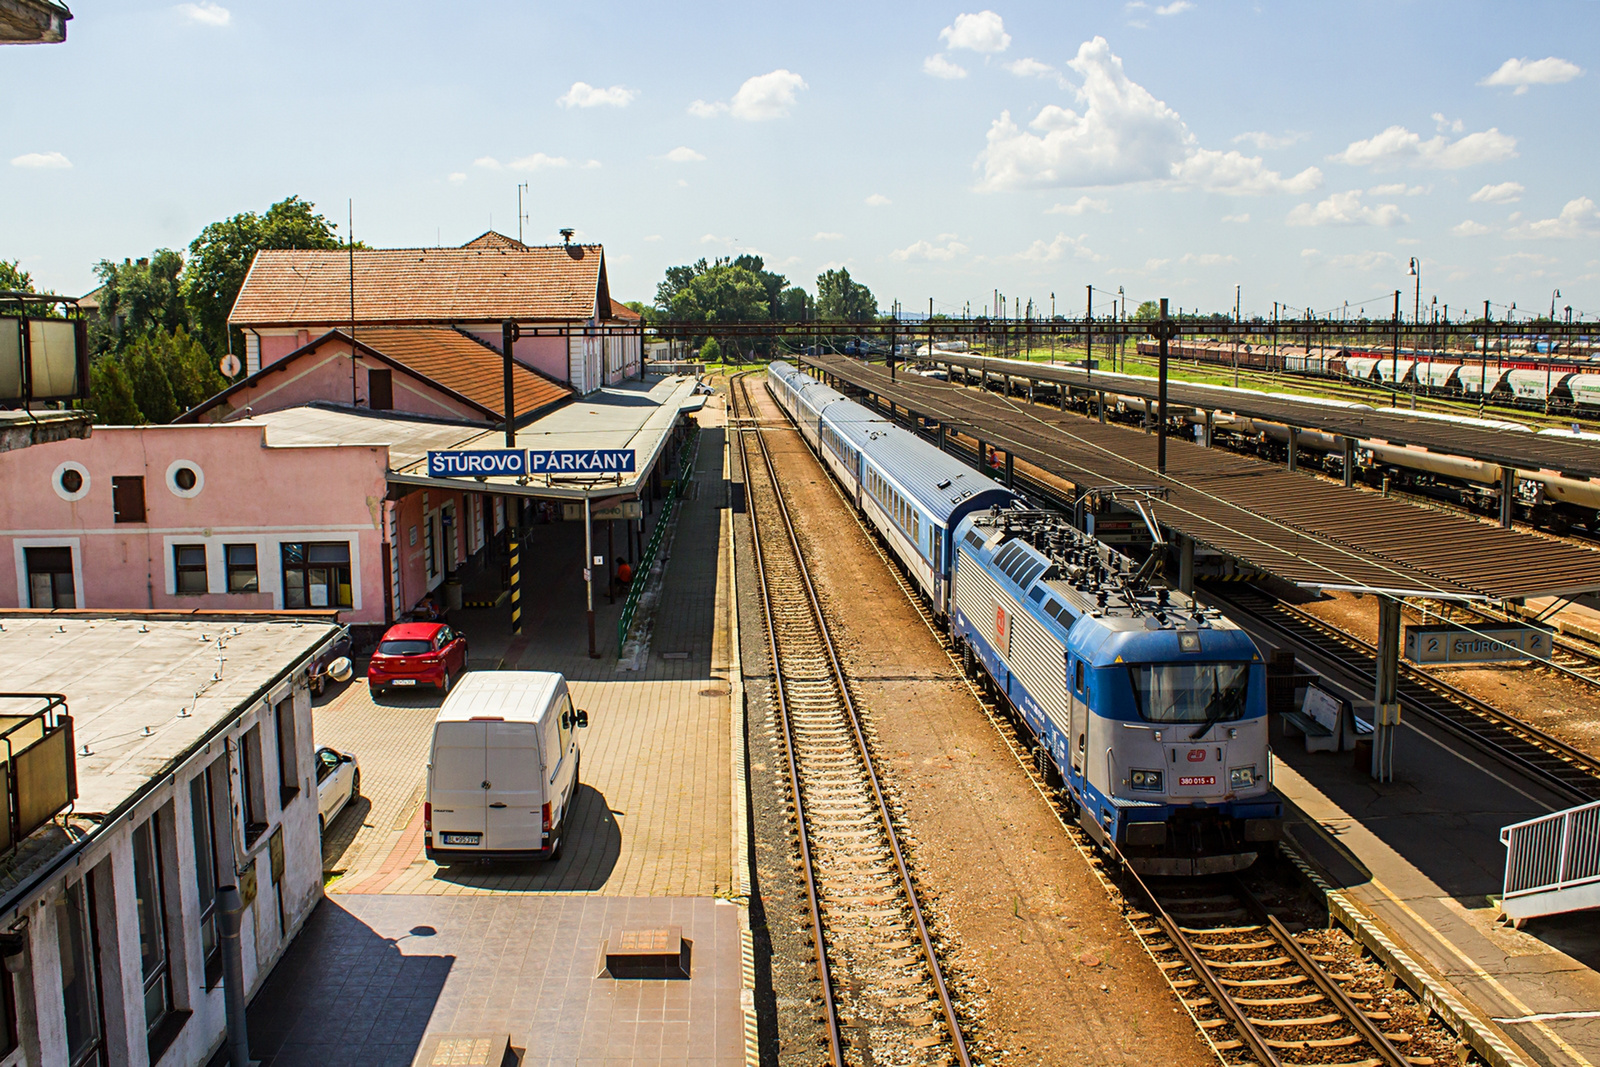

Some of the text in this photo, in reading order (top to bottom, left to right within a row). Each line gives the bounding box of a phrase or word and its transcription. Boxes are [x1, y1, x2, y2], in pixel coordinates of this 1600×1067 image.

[432, 453, 522, 472] ŠTÚROVO
[533, 451, 631, 470] PÁRKÁNY
[1428, 635, 1543, 654] 2 ŠTÚROVO 2
[1181, 777, 1193, 785] 380
